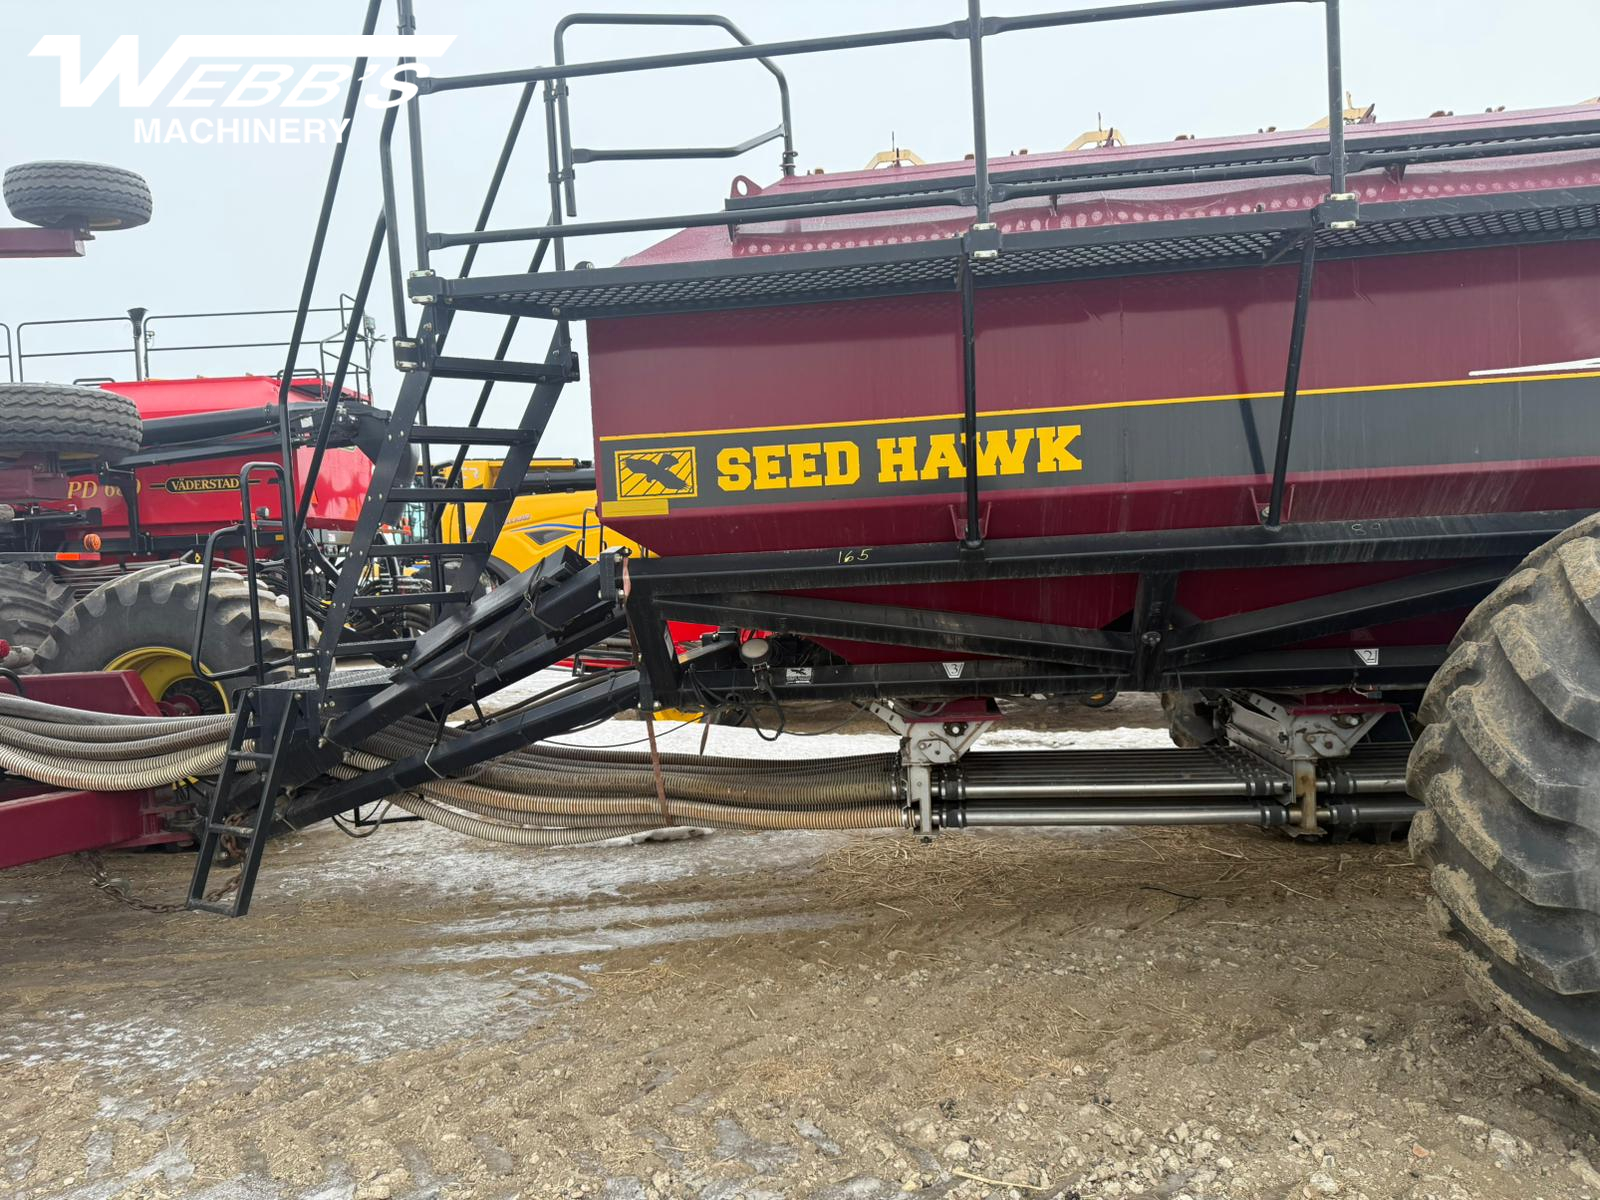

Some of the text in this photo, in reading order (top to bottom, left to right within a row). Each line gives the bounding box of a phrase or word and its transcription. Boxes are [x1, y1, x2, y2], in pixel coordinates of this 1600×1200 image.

[717, 424, 1083, 492] SEED HAWK
[67, 480, 98, 499] PD
[171, 477, 240, 492] VÄDERSTAD
[838, 548, 873, 564] 165
[1363, 650, 1375, 661] 2
